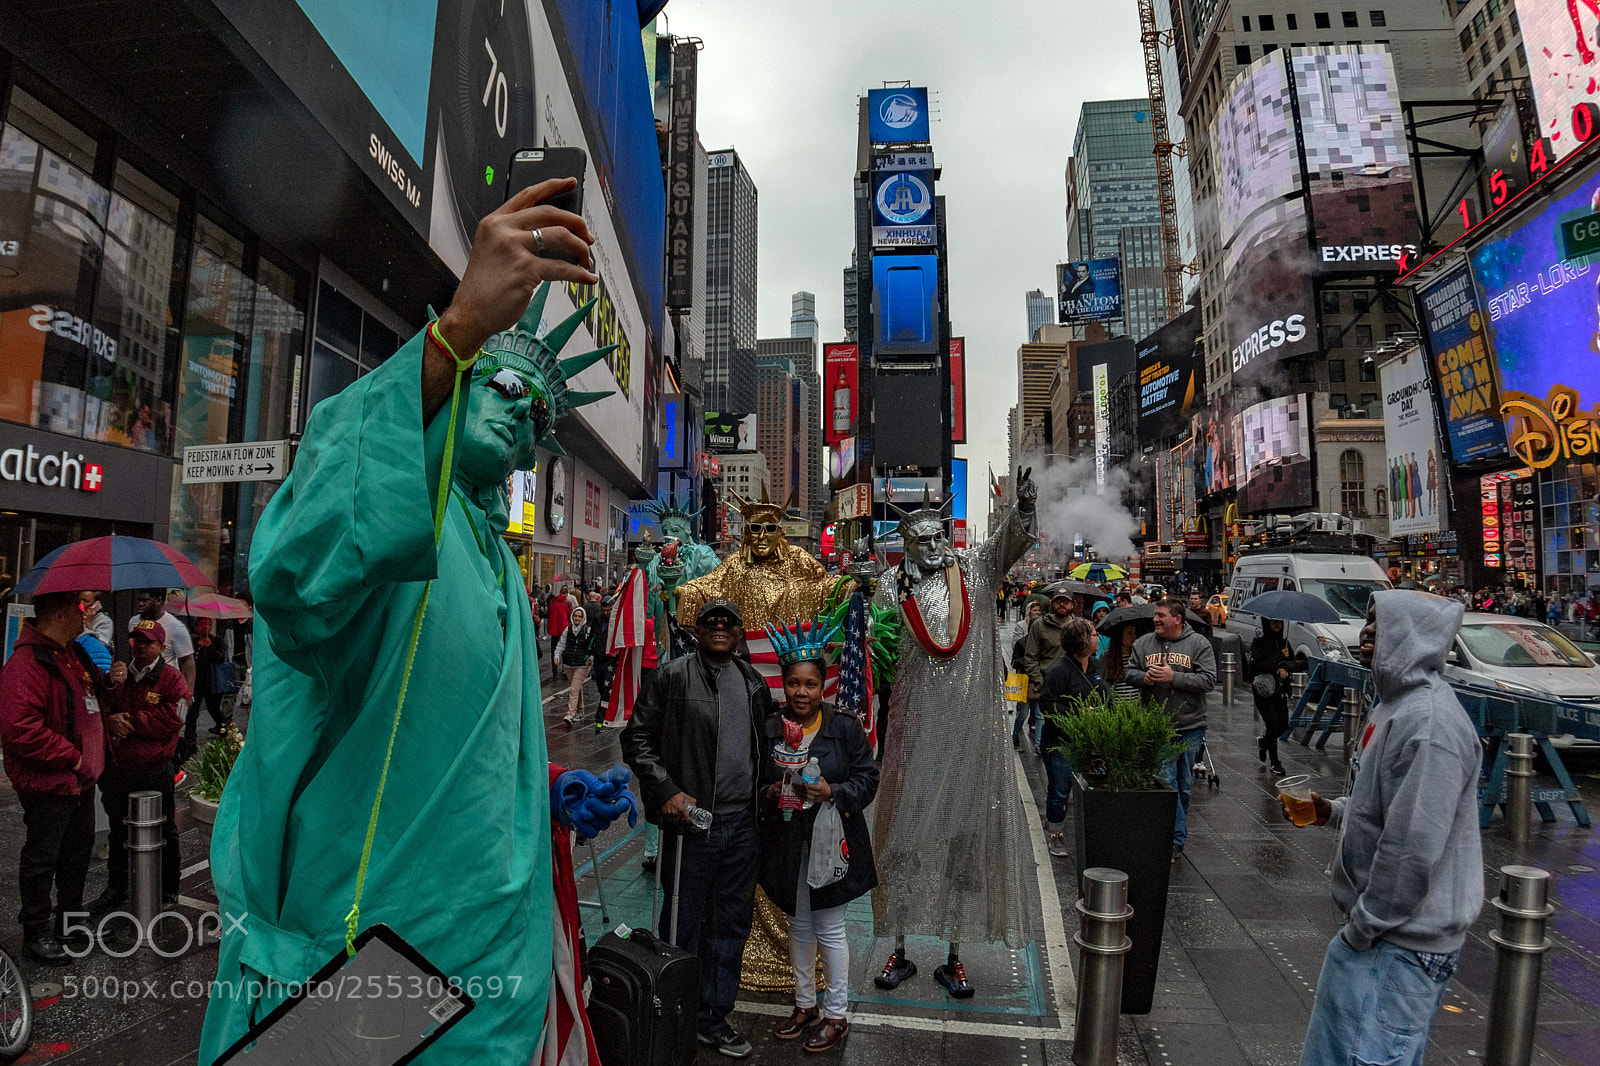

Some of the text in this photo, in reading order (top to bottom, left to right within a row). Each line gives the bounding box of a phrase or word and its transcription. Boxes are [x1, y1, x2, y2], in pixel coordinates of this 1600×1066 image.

[369, 133, 405, 191] SWISS
[672, 65, 692, 276] TIMES SQUARE
[1060, 295, 1119, 310] PHANTOM
[1232, 314, 1306, 374] EXPRESS
[1438, 335, 1486, 375] COME
[1141, 369, 1179, 397] AUTOMOTIVE
[1387, 378, 1430, 406] GROUNDHOG
[1142, 387, 1168, 408] BATTERY
[1401, 397, 1413, 412] DAY
[1449, 382, 1492, 422] AWAY
[187, 446, 276, 463] PEDESTRIAN FLOW ZONE
[186, 464, 235, 478] KEEP MOVING
